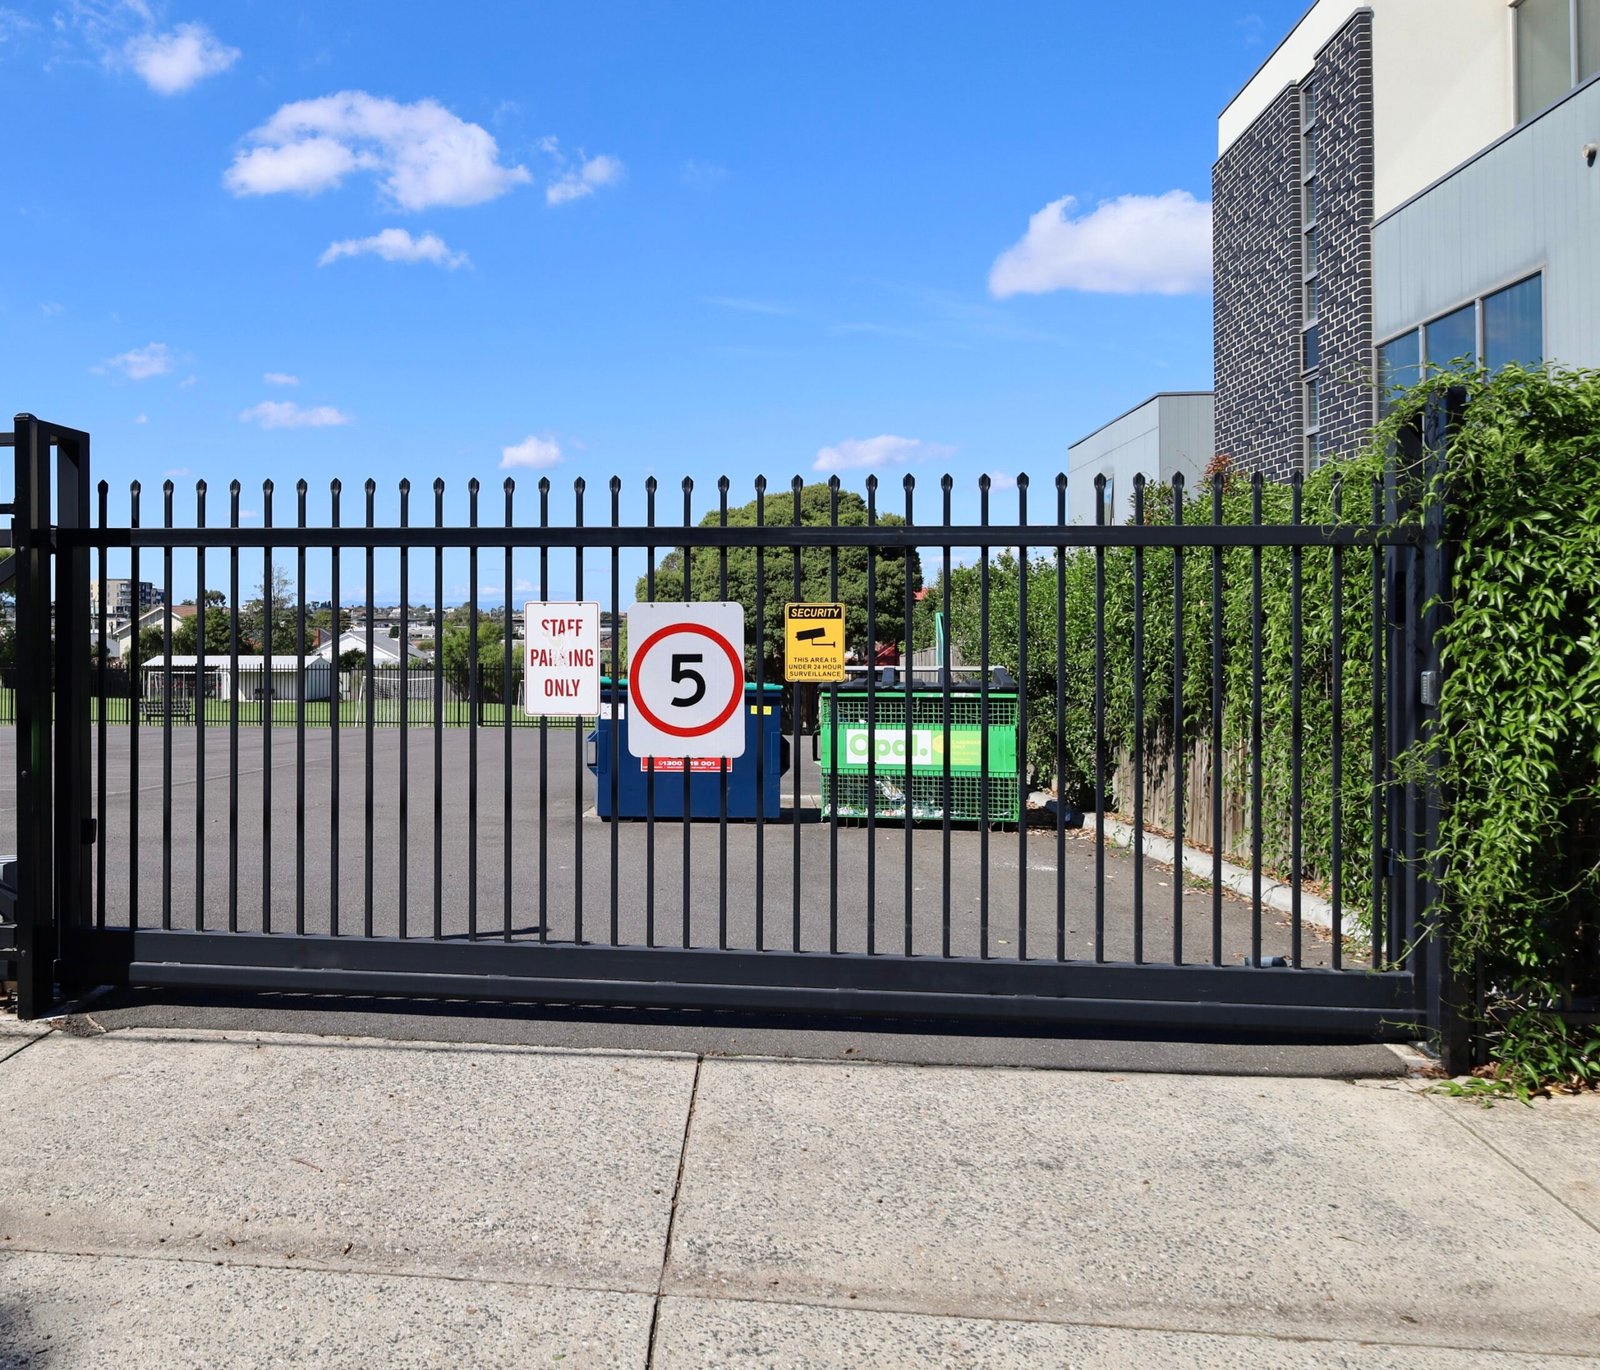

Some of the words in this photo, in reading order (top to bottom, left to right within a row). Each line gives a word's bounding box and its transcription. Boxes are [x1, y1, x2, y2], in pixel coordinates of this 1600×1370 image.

[791, 608, 840, 617] SECURITY
[541, 619, 583, 637] STAFF
[530, 649, 594, 667] PAING
[544, 679, 581, 697] ONLY
[671, 653, 706, 707] 5
